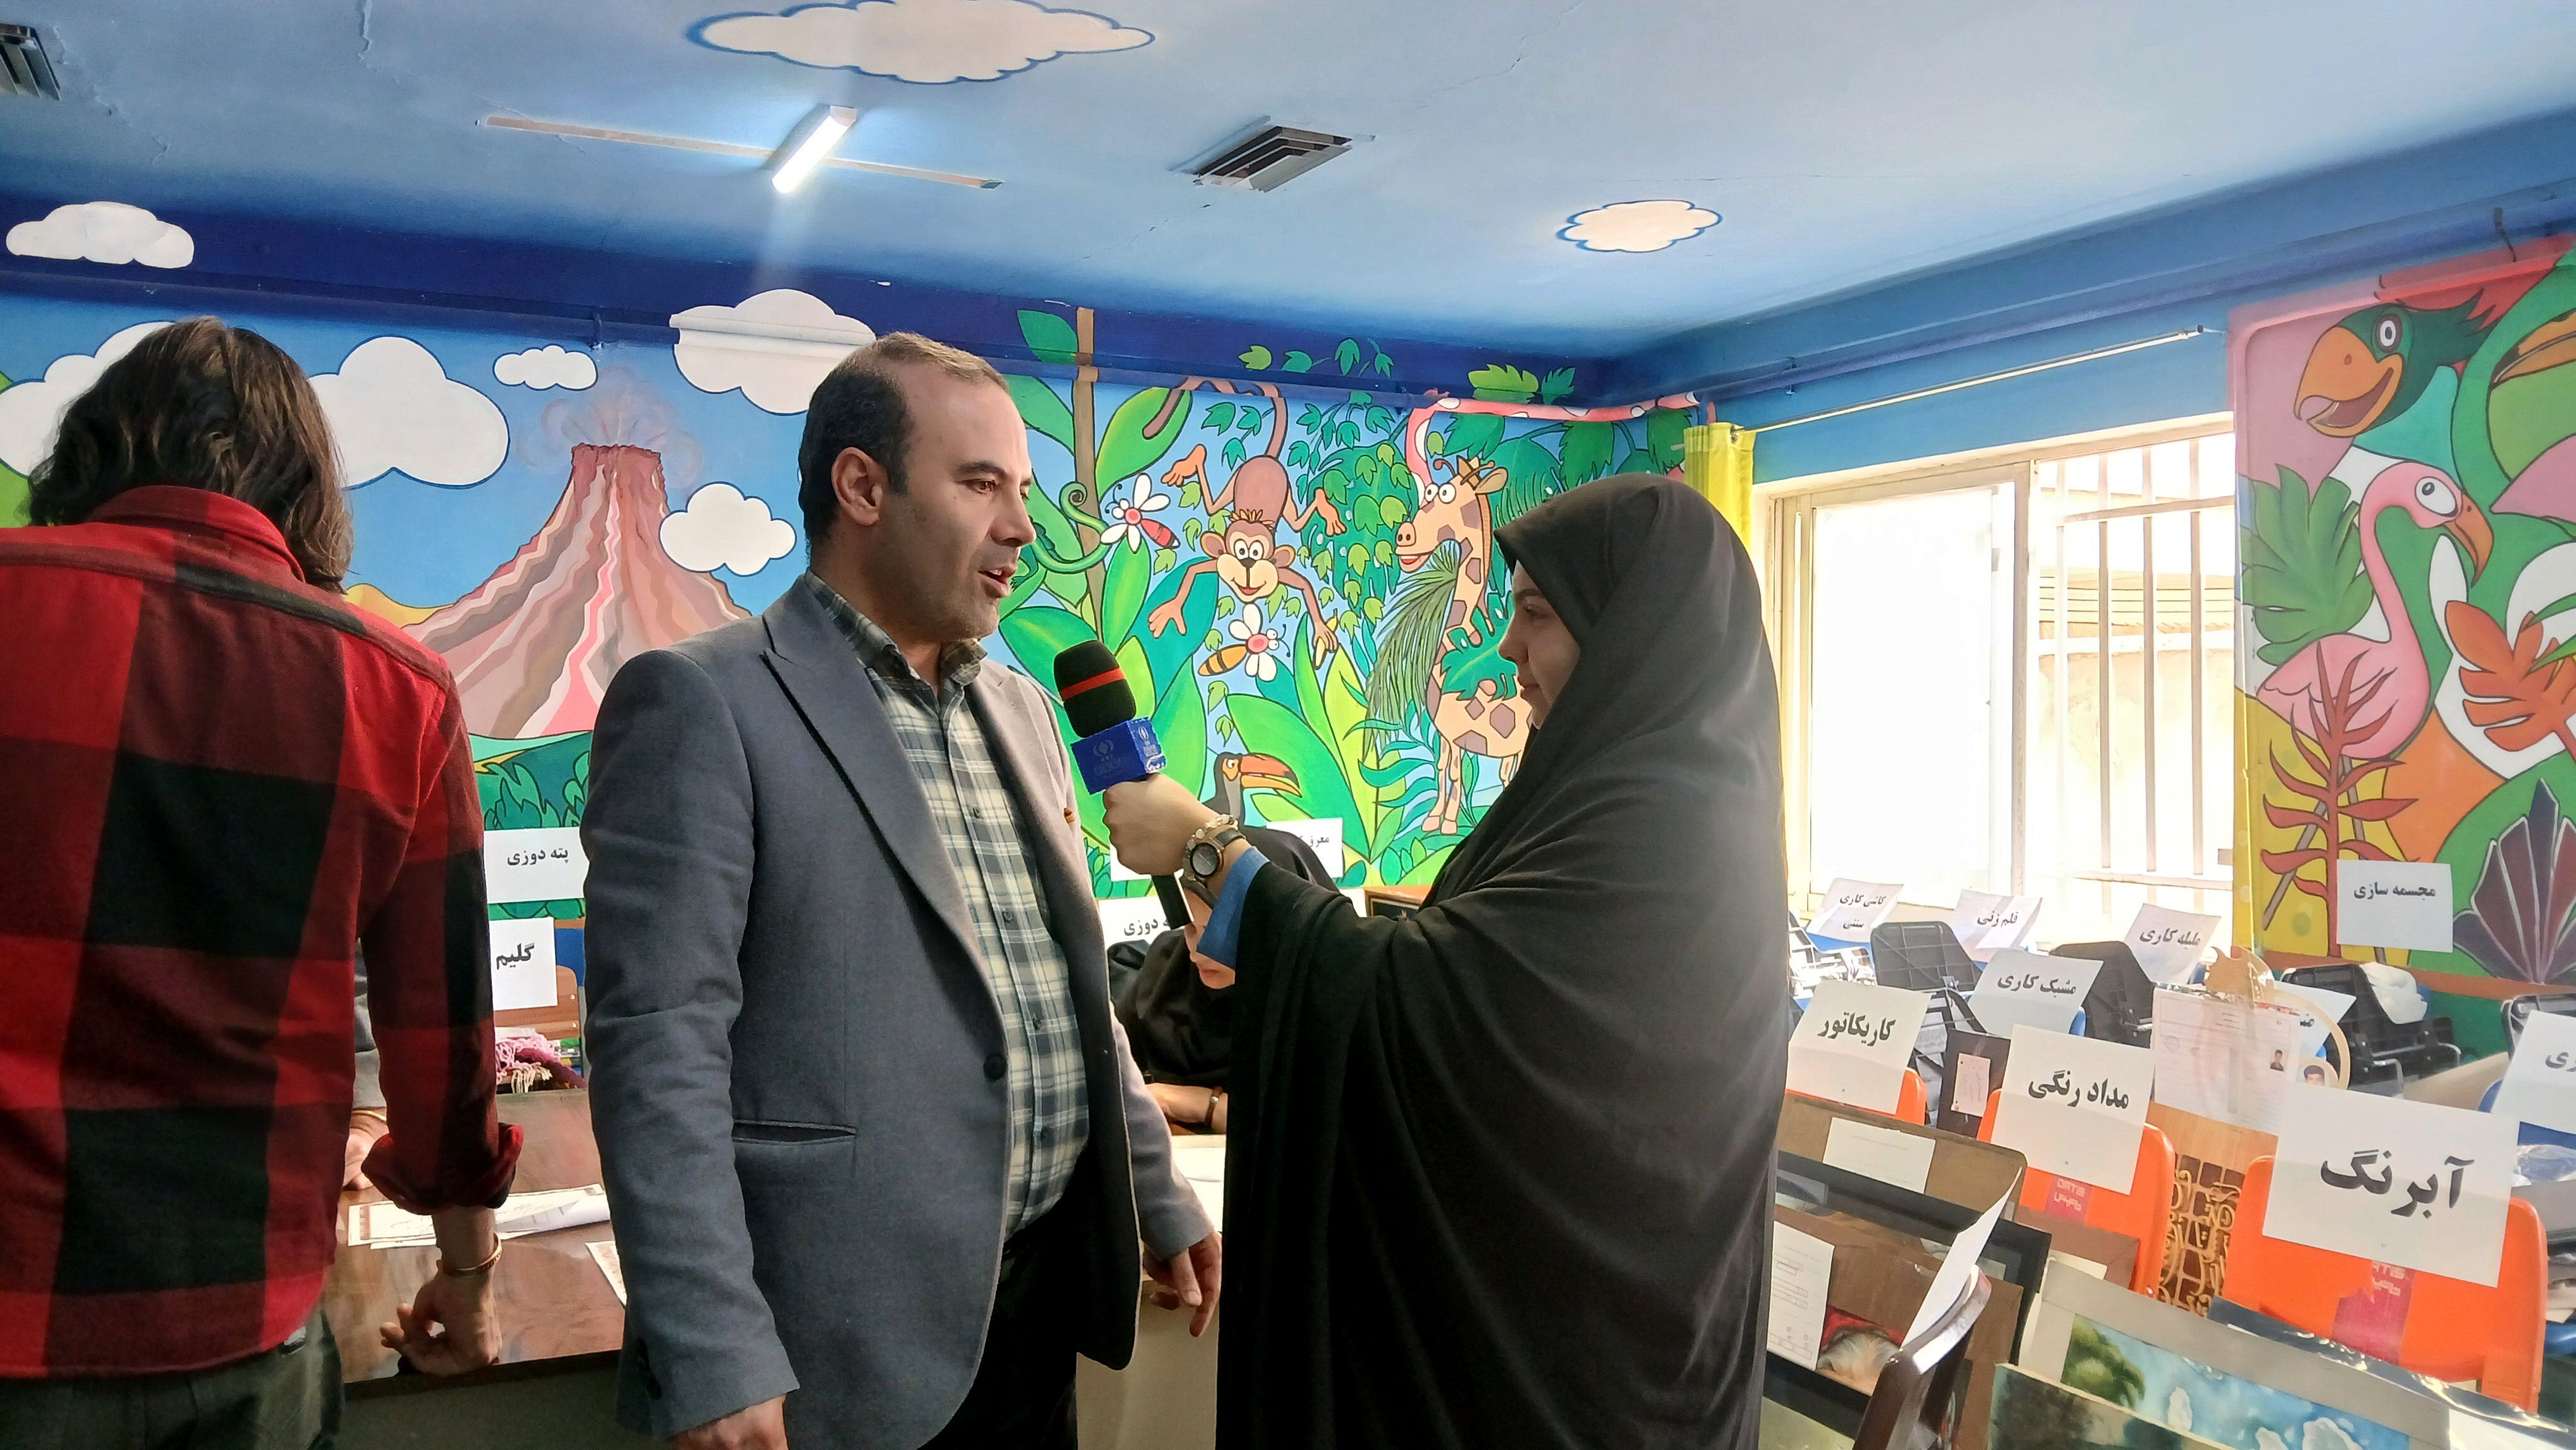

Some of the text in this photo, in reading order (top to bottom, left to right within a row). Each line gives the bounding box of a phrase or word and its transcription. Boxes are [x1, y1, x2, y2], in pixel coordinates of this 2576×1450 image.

[507, 848, 569, 866] پته دوزی
[1839, 894, 1887, 907] کاشی کاری
[2354, 882, 2436, 901] مجسمه سازی
[1124, 918, 1159, 936] دوزی
[1977, 910, 2018, 928] قلم زنی
[2139, 928, 2201, 950] ملیله کاری
[496, 942, 535, 970] گلیم
[1997, 973, 2077, 998] مشبک کاری
[1817, 1012, 1896, 1046] کاریکاتور
[2028, 1070, 2129, 1109] مداد رنگی
[2320, 1149, 2475, 1219] آبرنگ
